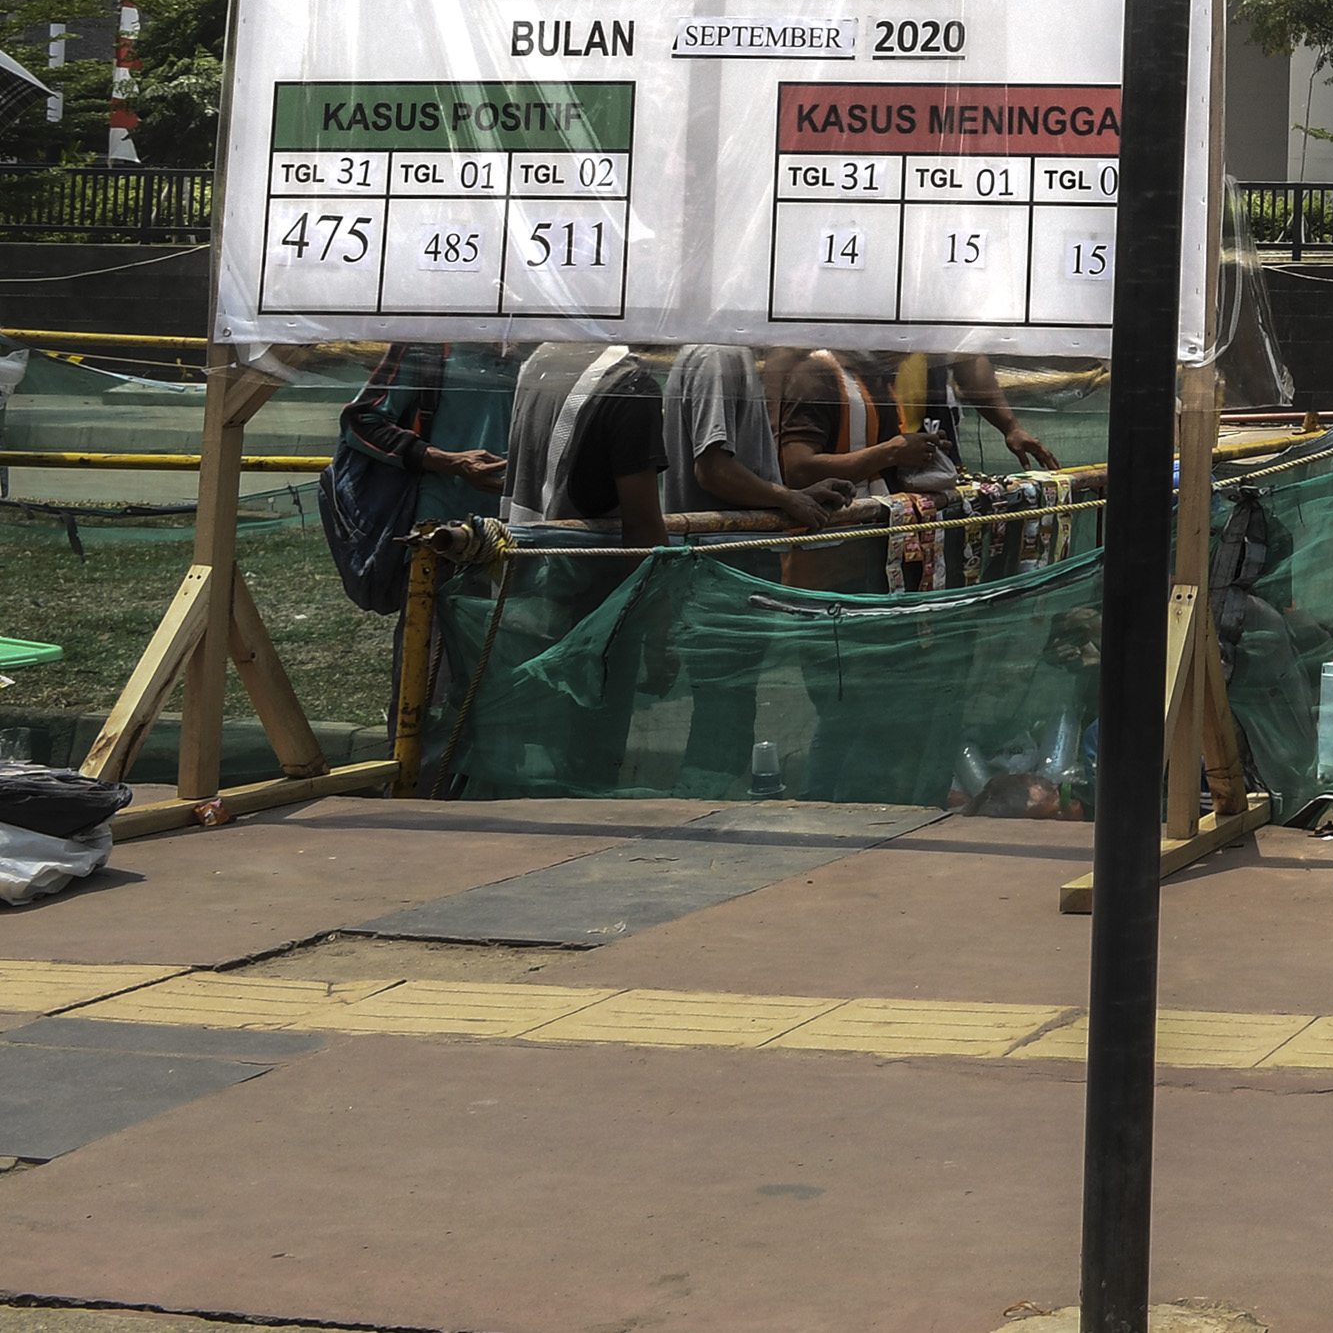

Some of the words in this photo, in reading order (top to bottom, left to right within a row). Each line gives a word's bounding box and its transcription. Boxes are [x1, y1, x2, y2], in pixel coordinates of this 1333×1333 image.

[511, 21, 634, 56] BULAN
[685, 24, 843, 49] SEPTEMBER
[875, 21, 965, 52] 2020
[323, 103, 439, 131] KASUS
[451, 102, 584, 132] POSITIF
[798, 104, 916, 134] KASUS
[929, 105, 1120, 136] MENINGGA
[282, 164, 324, 182] TGL
[337, 158, 370, 186] 31
[401, 164, 444, 183] TGL
[461, 162, 493, 188] 01
[521, 165, 564, 183] TGL
[579, 157, 614, 186] 02
[788, 167, 834, 186] TGL
[842, 163, 878, 190] 31
[916, 169, 962, 188] TGL
[975, 168, 1014, 197] 01
[1044, 170, 1091, 189] TGL
[282, 213, 372, 262] 475
[425, 234, 478, 262] 485
[527, 223, 605, 266] 511
[825, 235, 858, 263] 14
[949, 234, 980, 263] 15
[1074, 245, 1106, 274] 15
